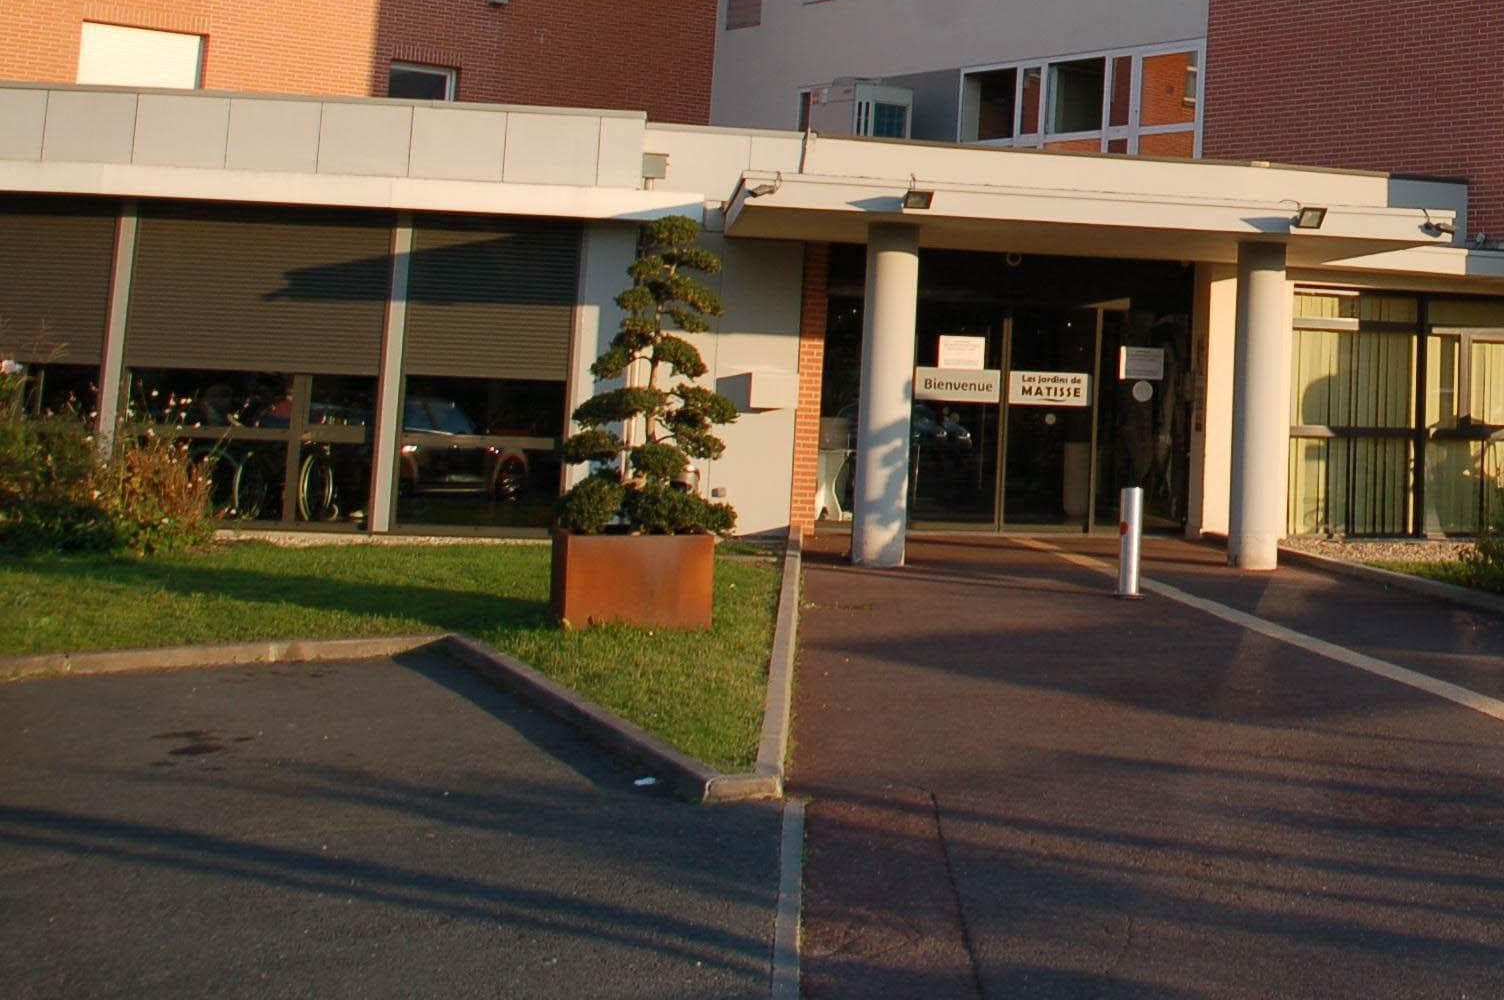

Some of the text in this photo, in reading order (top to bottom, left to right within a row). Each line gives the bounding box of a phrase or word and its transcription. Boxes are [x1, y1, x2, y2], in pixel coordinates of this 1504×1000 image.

[923, 378, 993, 392] Bienvenue
[1022, 374, 1036, 383] Les
[1070, 376, 1082, 384] de
[1021, 385, 1081, 398] MATISSE
